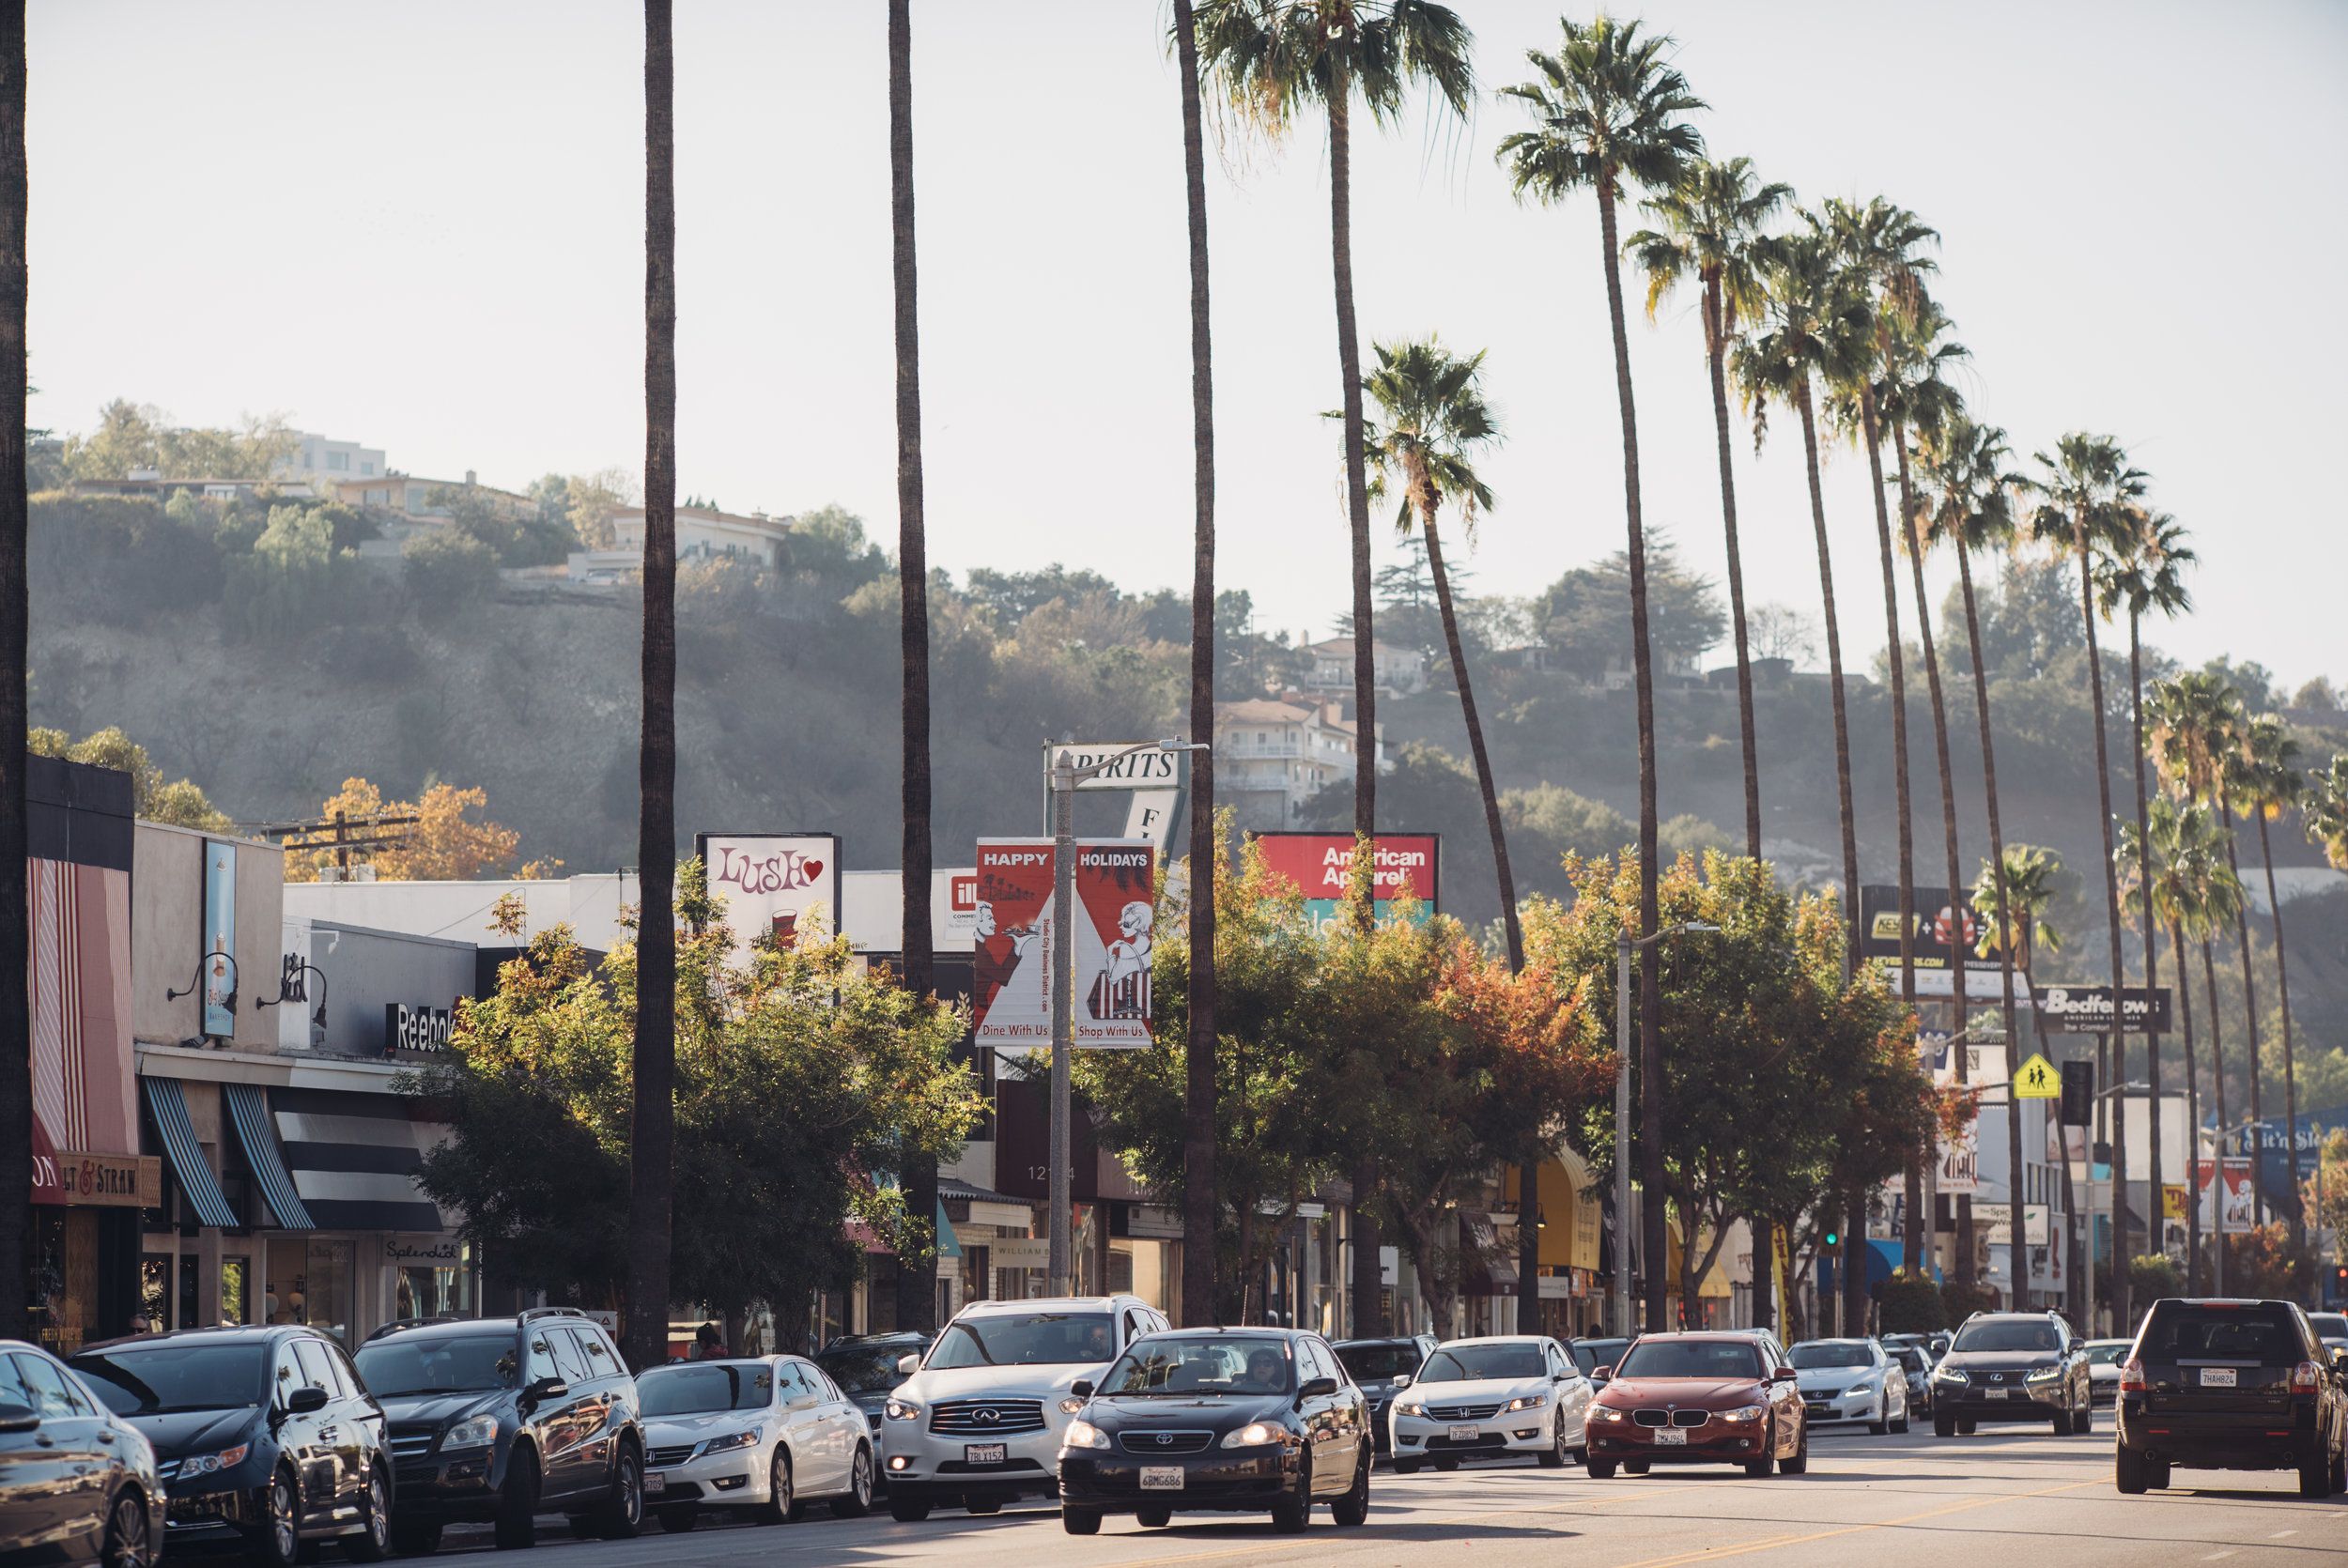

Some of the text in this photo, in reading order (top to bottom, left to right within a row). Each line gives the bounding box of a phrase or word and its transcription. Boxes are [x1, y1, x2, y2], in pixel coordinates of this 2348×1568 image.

[1072, 752, 1173, 778] PIRITS
[983, 853, 1148, 867] HAPPY HOLIDAYS
[1322, 847, 1426, 866] Amrican
[1322, 867, 1405, 888] Aprel
[1042, 937, 1050, 948] City
[1042, 976, 1050, 996] District
[2045, 989, 2159, 1014] Bedfelow
[397, 1003, 456, 1052] Reebok
[983, 1024, 1048, 1036] Dine With Us
[1079, 1024, 1143, 1038] Shop With Us
[63, 1167, 77, 1191] LT
[80, 1159, 95, 1196] &
[1028, 1166, 1075, 1181] 124
[1990, 1207, 2012, 1217] Spic
[386, 1241, 456, 1260] Splendid
[2203, 1374, 2234, 1384] 7HAH824
[644, 1478, 662, 1491] H709
[1142, 1475, 1182, 1486] 6BMG686
